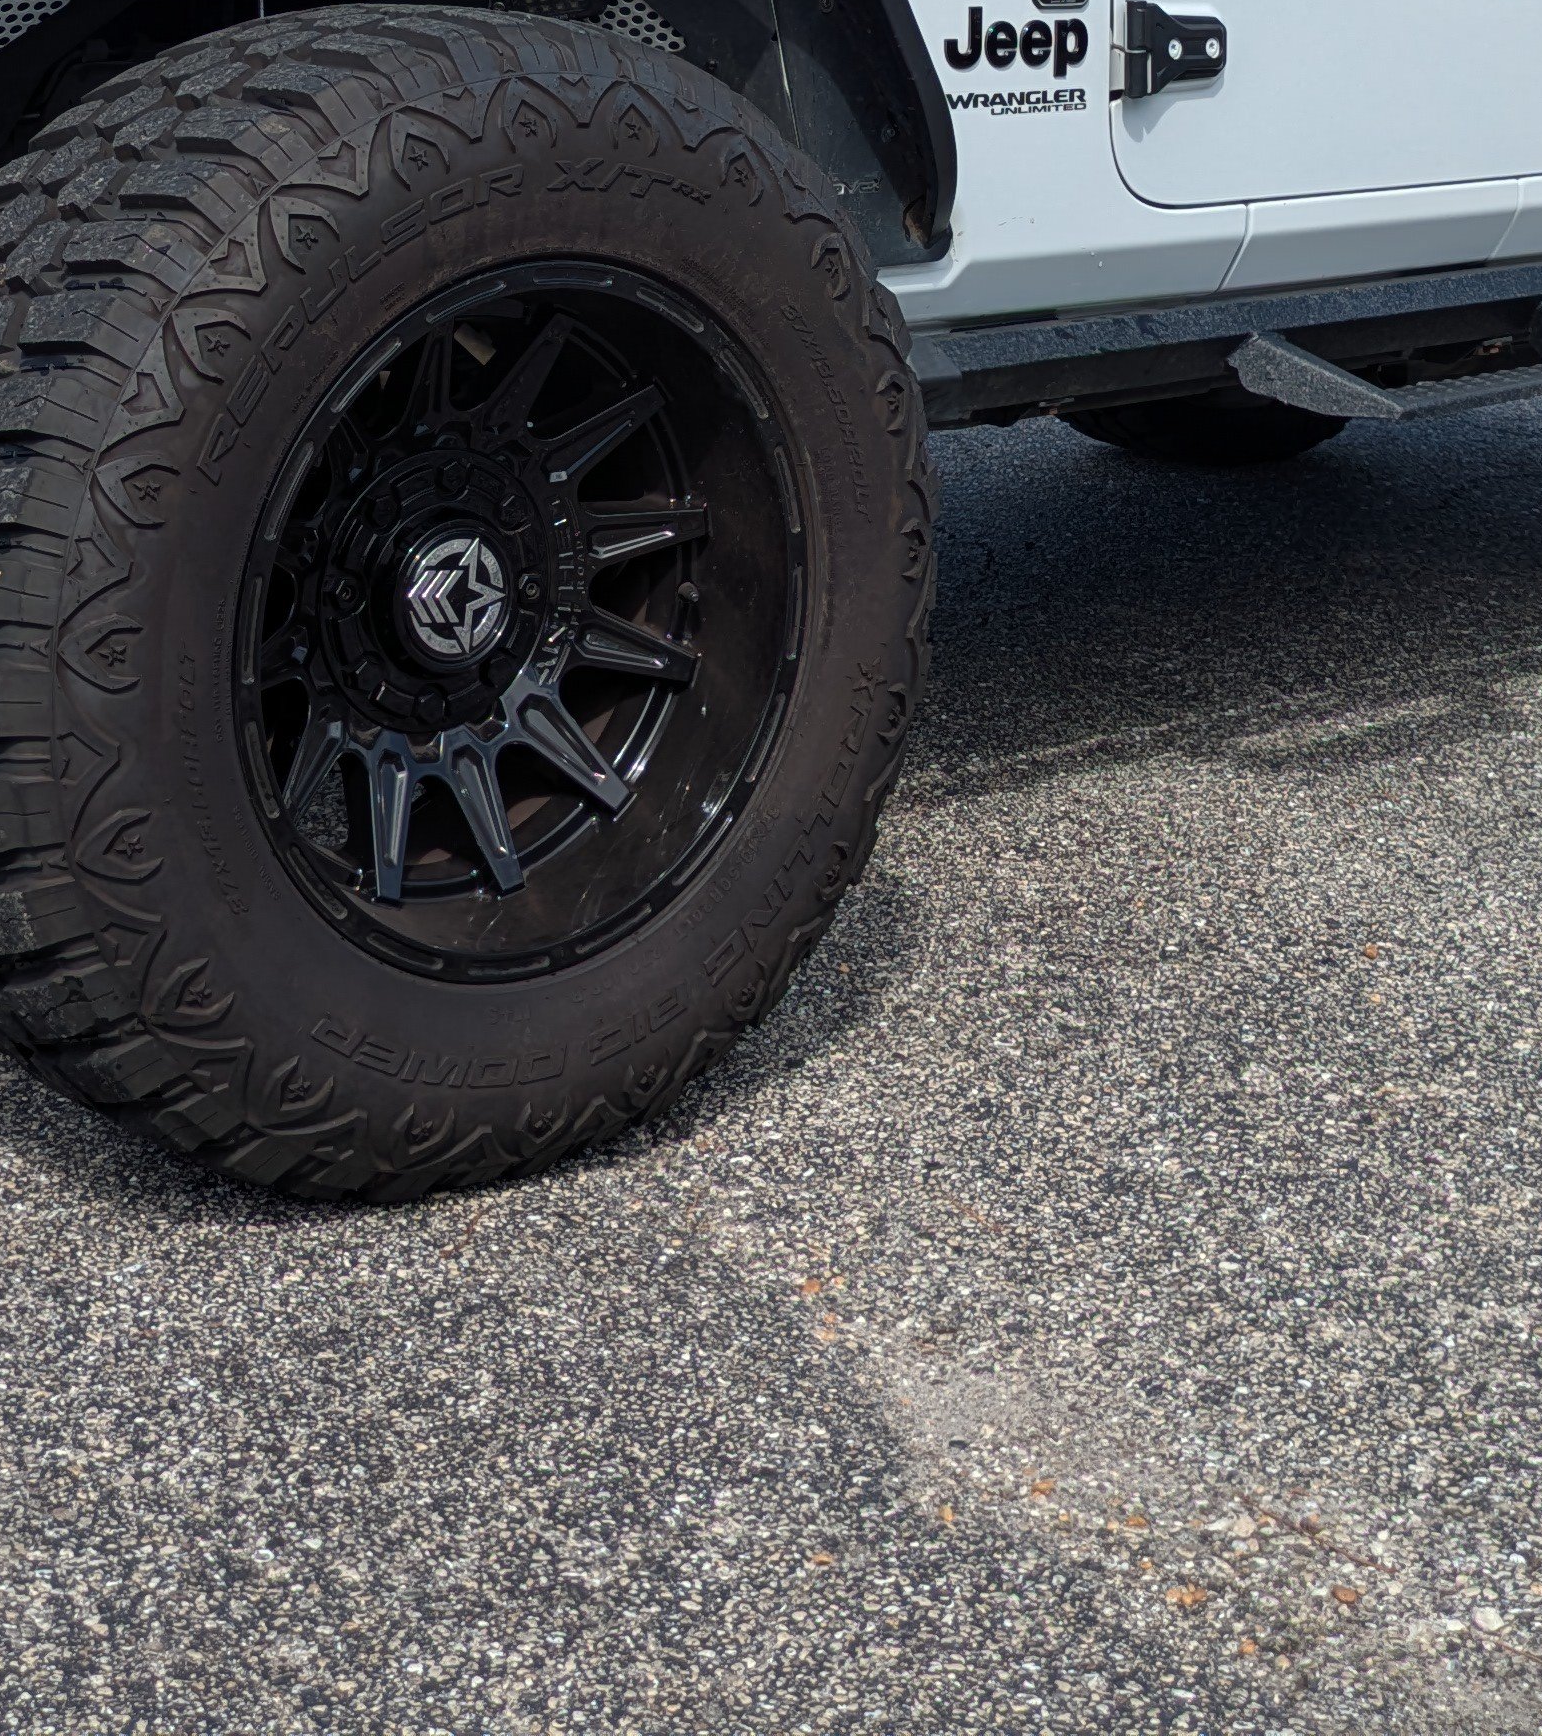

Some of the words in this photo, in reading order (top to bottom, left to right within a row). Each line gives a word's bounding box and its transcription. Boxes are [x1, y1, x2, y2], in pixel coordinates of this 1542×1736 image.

[944, 6, 1088, 79] Jeep
[946, 88, 1087, 110] WRANGLER
[991, 102, 1087, 116] UNLIMITED
[195, 161, 523, 487] REPULSOR
[305, 994, 570, 1101] POWER
[583, 983, 689, 1068] BIG
